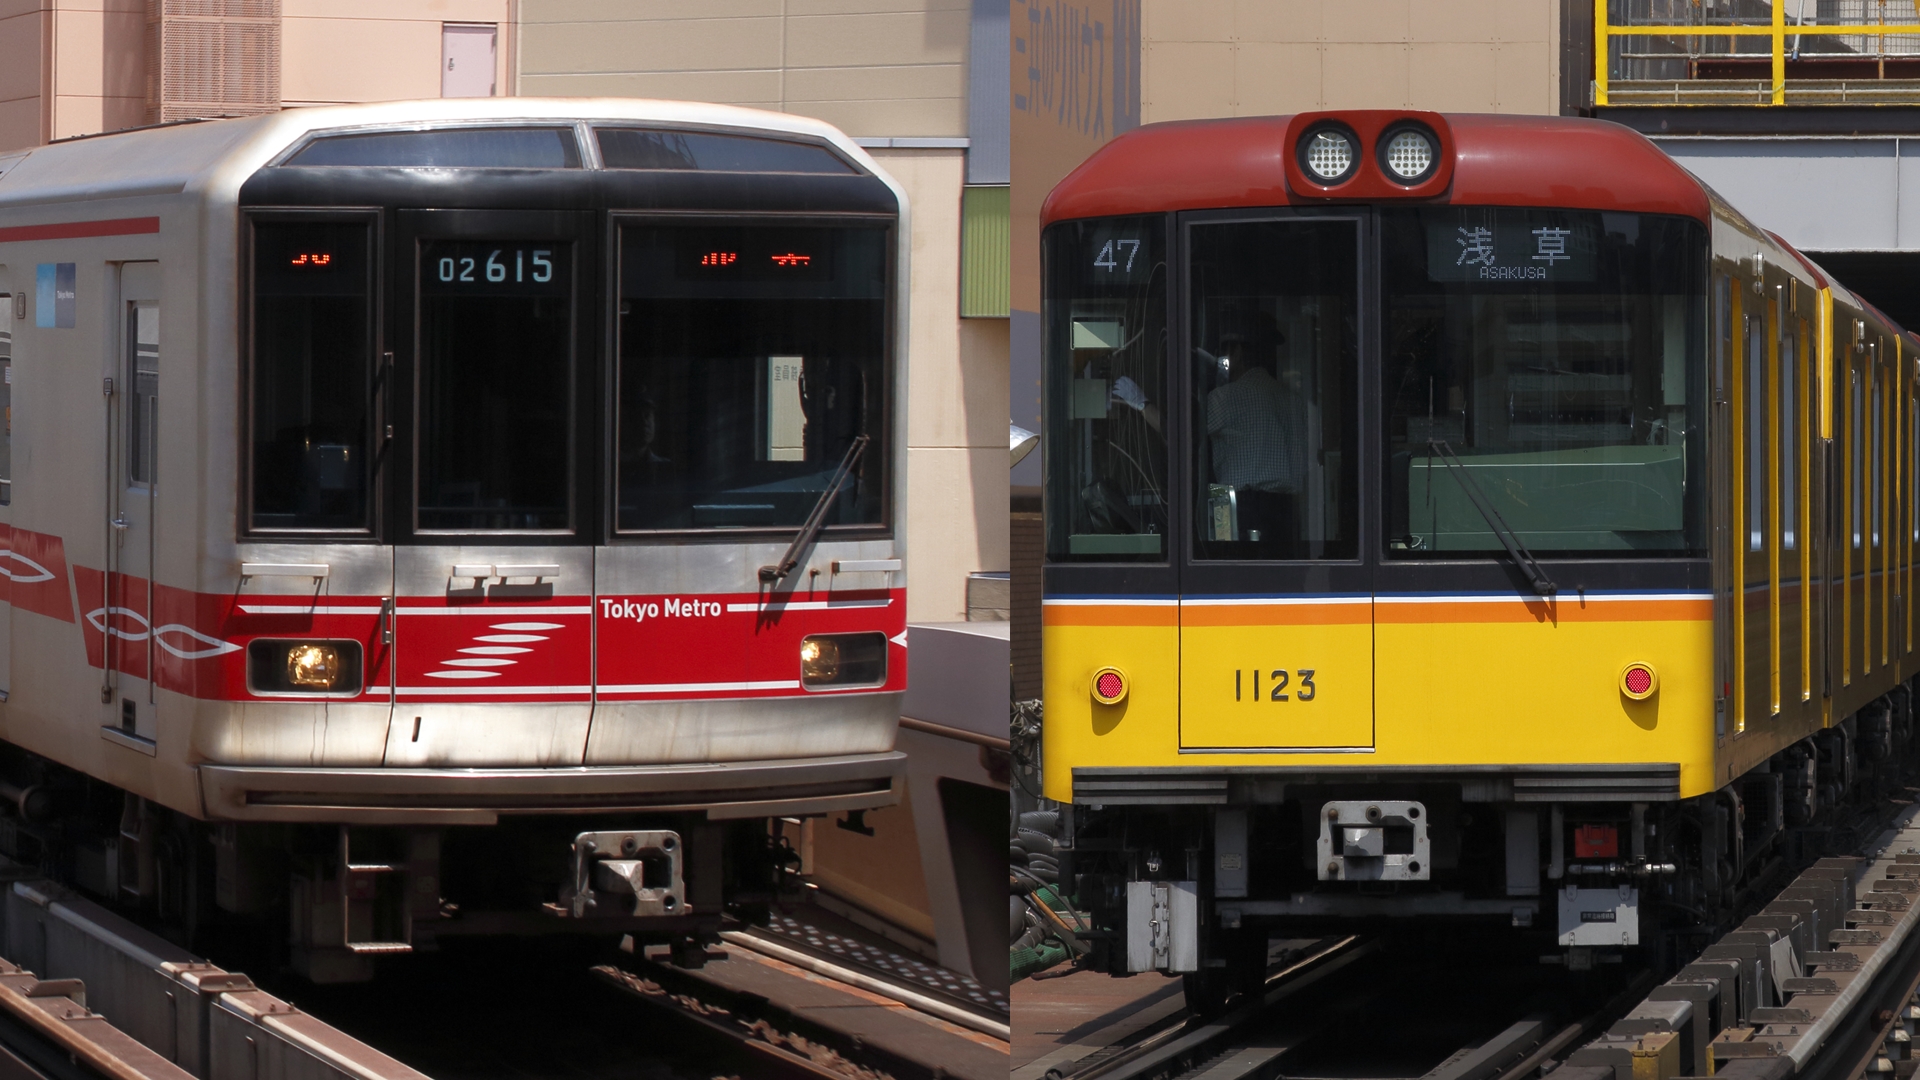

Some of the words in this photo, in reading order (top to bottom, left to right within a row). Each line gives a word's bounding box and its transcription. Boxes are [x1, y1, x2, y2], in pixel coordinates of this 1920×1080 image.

[1093, 239, 1141, 273] 47
[1456, 226, 1571, 266] 浅草
[1479, 266, 1546, 279] ASAKUSA
[600, 599, 659, 623] Tokyo
[664, 598, 722, 618] Metro
[1235, 668, 1316, 703] 1123
